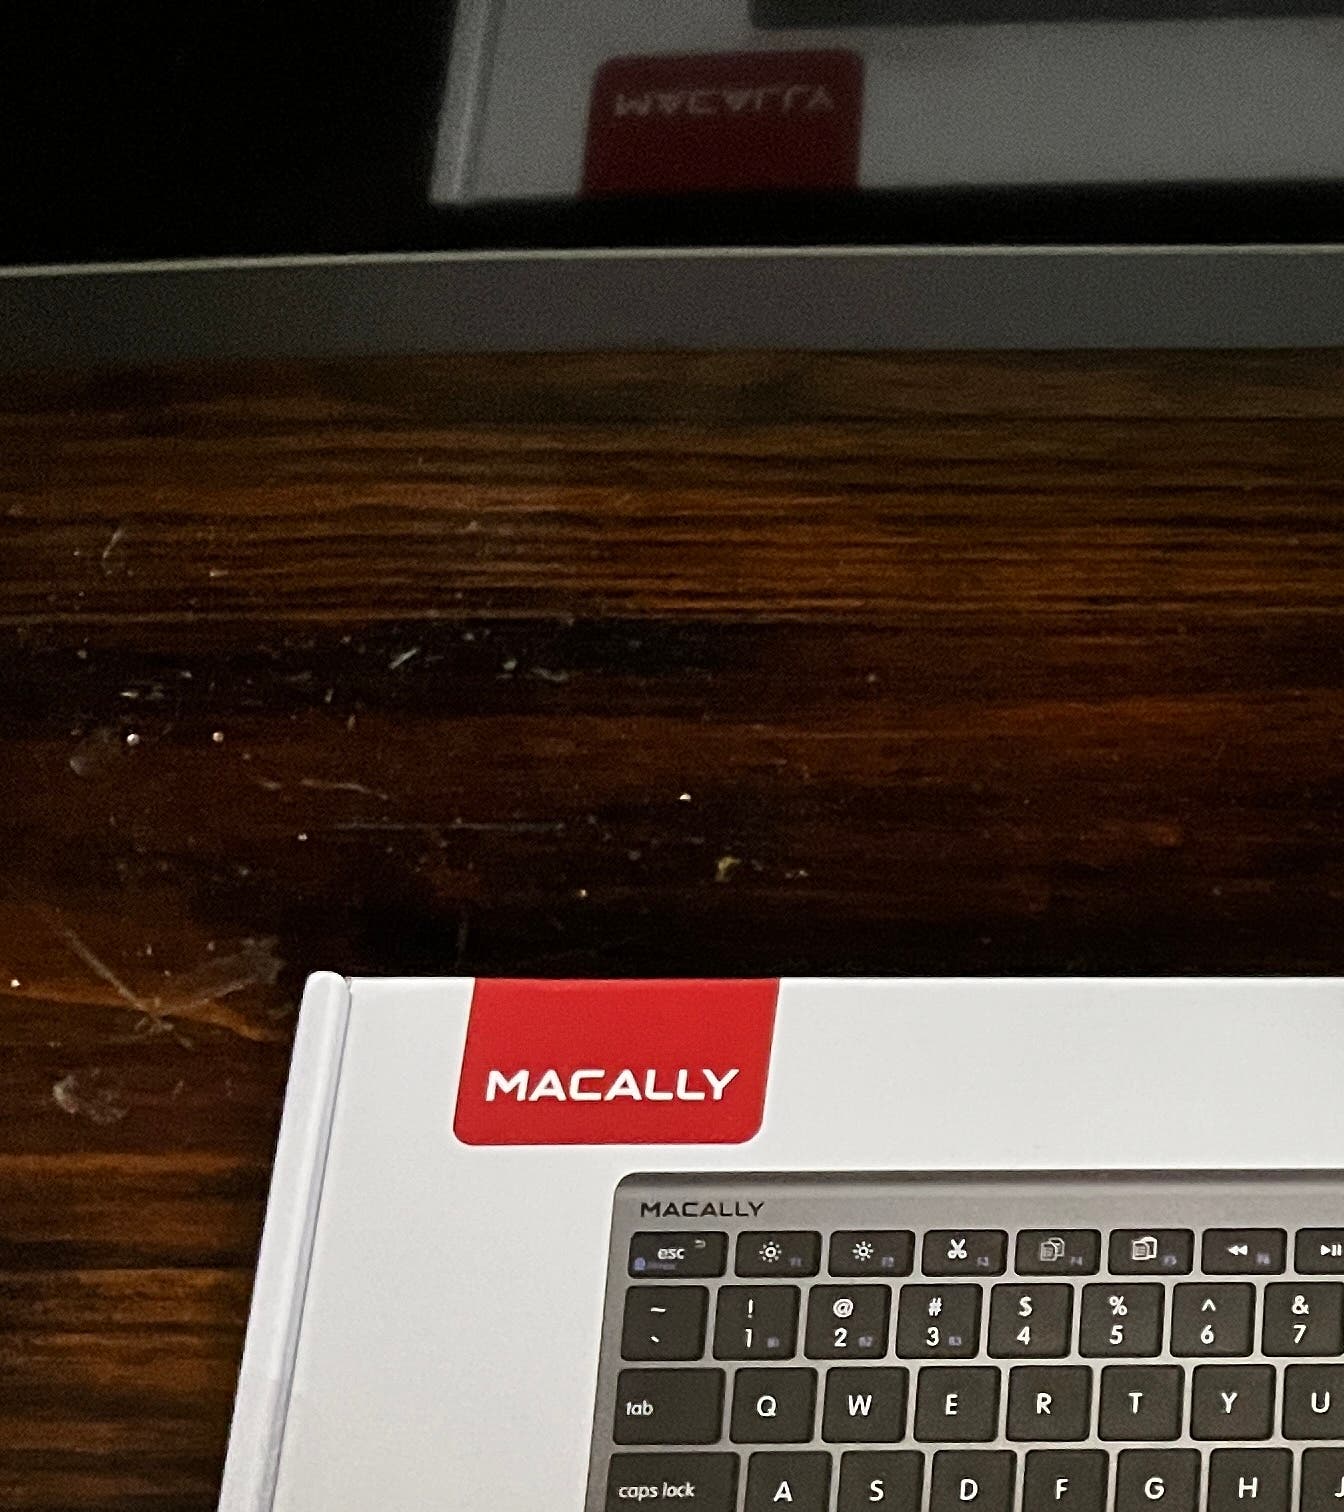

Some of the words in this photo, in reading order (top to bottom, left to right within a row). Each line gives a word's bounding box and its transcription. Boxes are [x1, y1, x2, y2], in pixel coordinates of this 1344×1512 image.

[485, 1068, 740, 1102] MACALLY
[640, 1201, 764, 1218] MACALLY
[657, 1248, 685, 1260] esc
[832, 1298, 854, 1318] @
[928, 1297, 943, 1317] #
[1108, 1295, 1128, 1316] %
[1291, 1294, 1310, 1315] &
[745, 1328, 753, 1348] 1
[834, 1327, 848, 1348] 2
[925, 1326, 940, 1347] 3
[1016, 1325, 1031, 1345] 4
[1108, 1324, 1124, 1345] 5
[1200, 1324, 1215, 1345] 6
[1293, 1324, 1307, 1344] 7
[626, 1399, 654, 1416] tab
[756, 1395, 777, 1417] Q
[848, 1394, 873, 1417] W
[944, 1393, 958, 1416] E
[1036, 1392, 1052, 1415] R
[1128, 1392, 1143, 1415] T
[1220, 1391, 1238, 1414] Y
[1310, 1391, 1331, 1414] U
[618, 1486, 659, 1502] caps
[662, 1481, 696, 1498] lock
[773, 1480, 793, 1502] A
[869, 1479, 884, 1502] S
[959, 1478, 979, 1501] D
[1055, 1478, 1069, 1500] F
[1144, 1476, 1165, 1500] G
[1238, 1476, 1258, 1499] H
